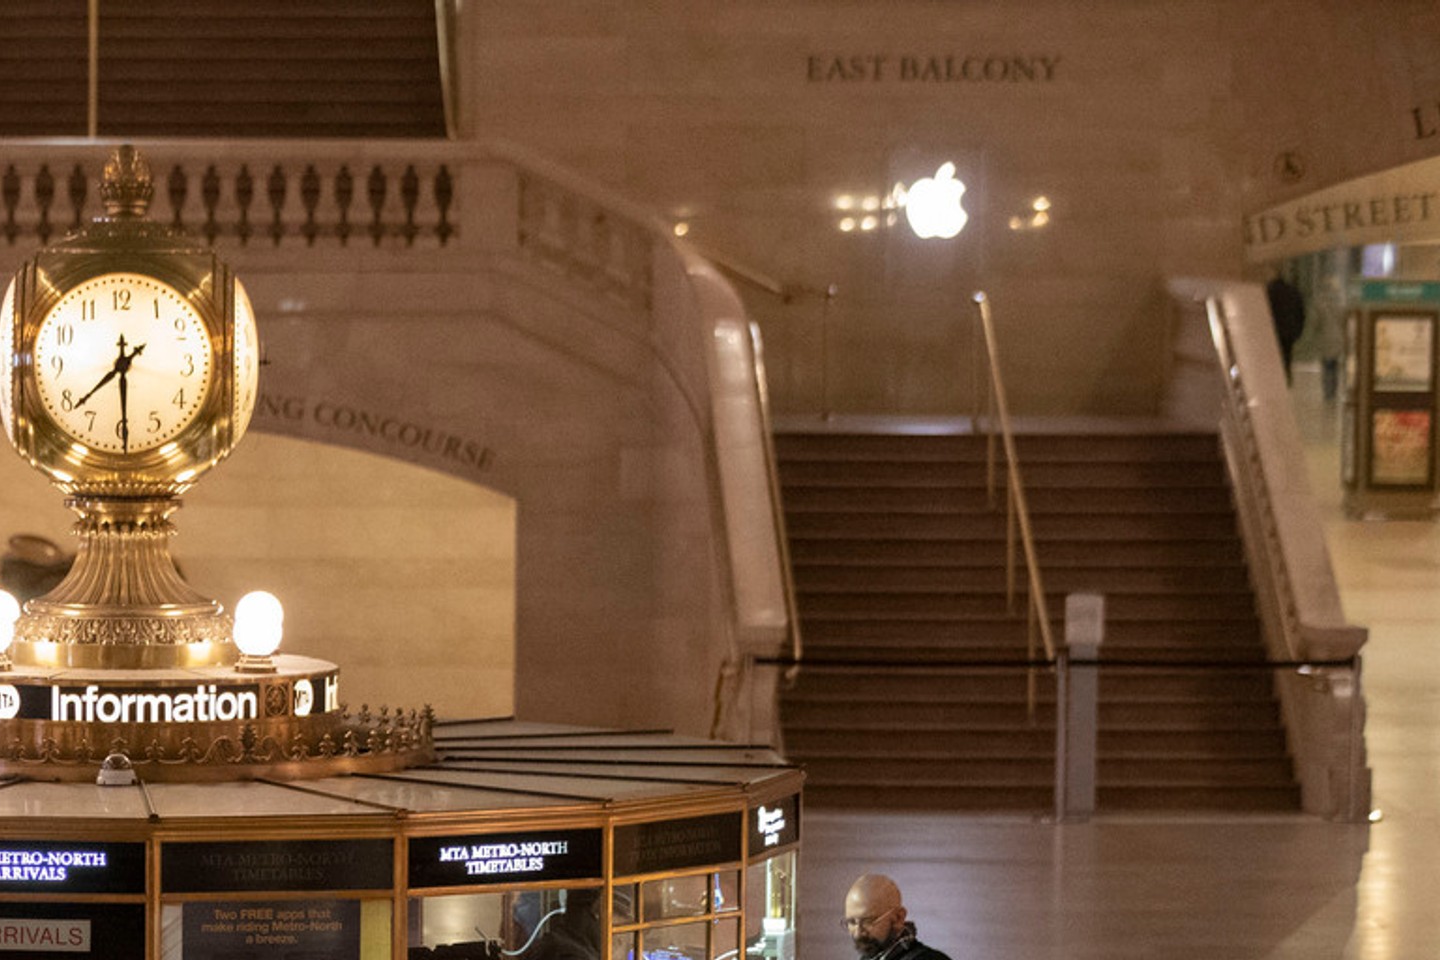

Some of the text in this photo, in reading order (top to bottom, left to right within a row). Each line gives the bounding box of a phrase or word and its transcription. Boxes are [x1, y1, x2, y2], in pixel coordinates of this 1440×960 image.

[807, 55, 1061, 83] EAST BALCONY
[1295, 192, 1437, 238] STREET
[81, 299, 96, 322] 11
[112, 288, 132, 311] 12
[153, 298, 160, 320] 1
[56, 323, 74, 346] 10
[174, 317, 187, 341] 2
[51, 354, 64, 381] 9
[180, 353, 195, 378] 3
[60, 388, 74, 413] 8
[172, 387, 187, 410] 4
[83, 410, 98, 433] 7
[146, 410, 162, 434] 5
[313, 402, 498, 471] CONCOURSE
[51, 684, 257, 723] Information
[439, 841, 568, 862] MTA METRO-NORTH
[465, 857, 544, 875] TIMETABLES
[214, 908, 332, 921] Two FREE apps that
[201, 921, 343, 934] make riding Metro-North
